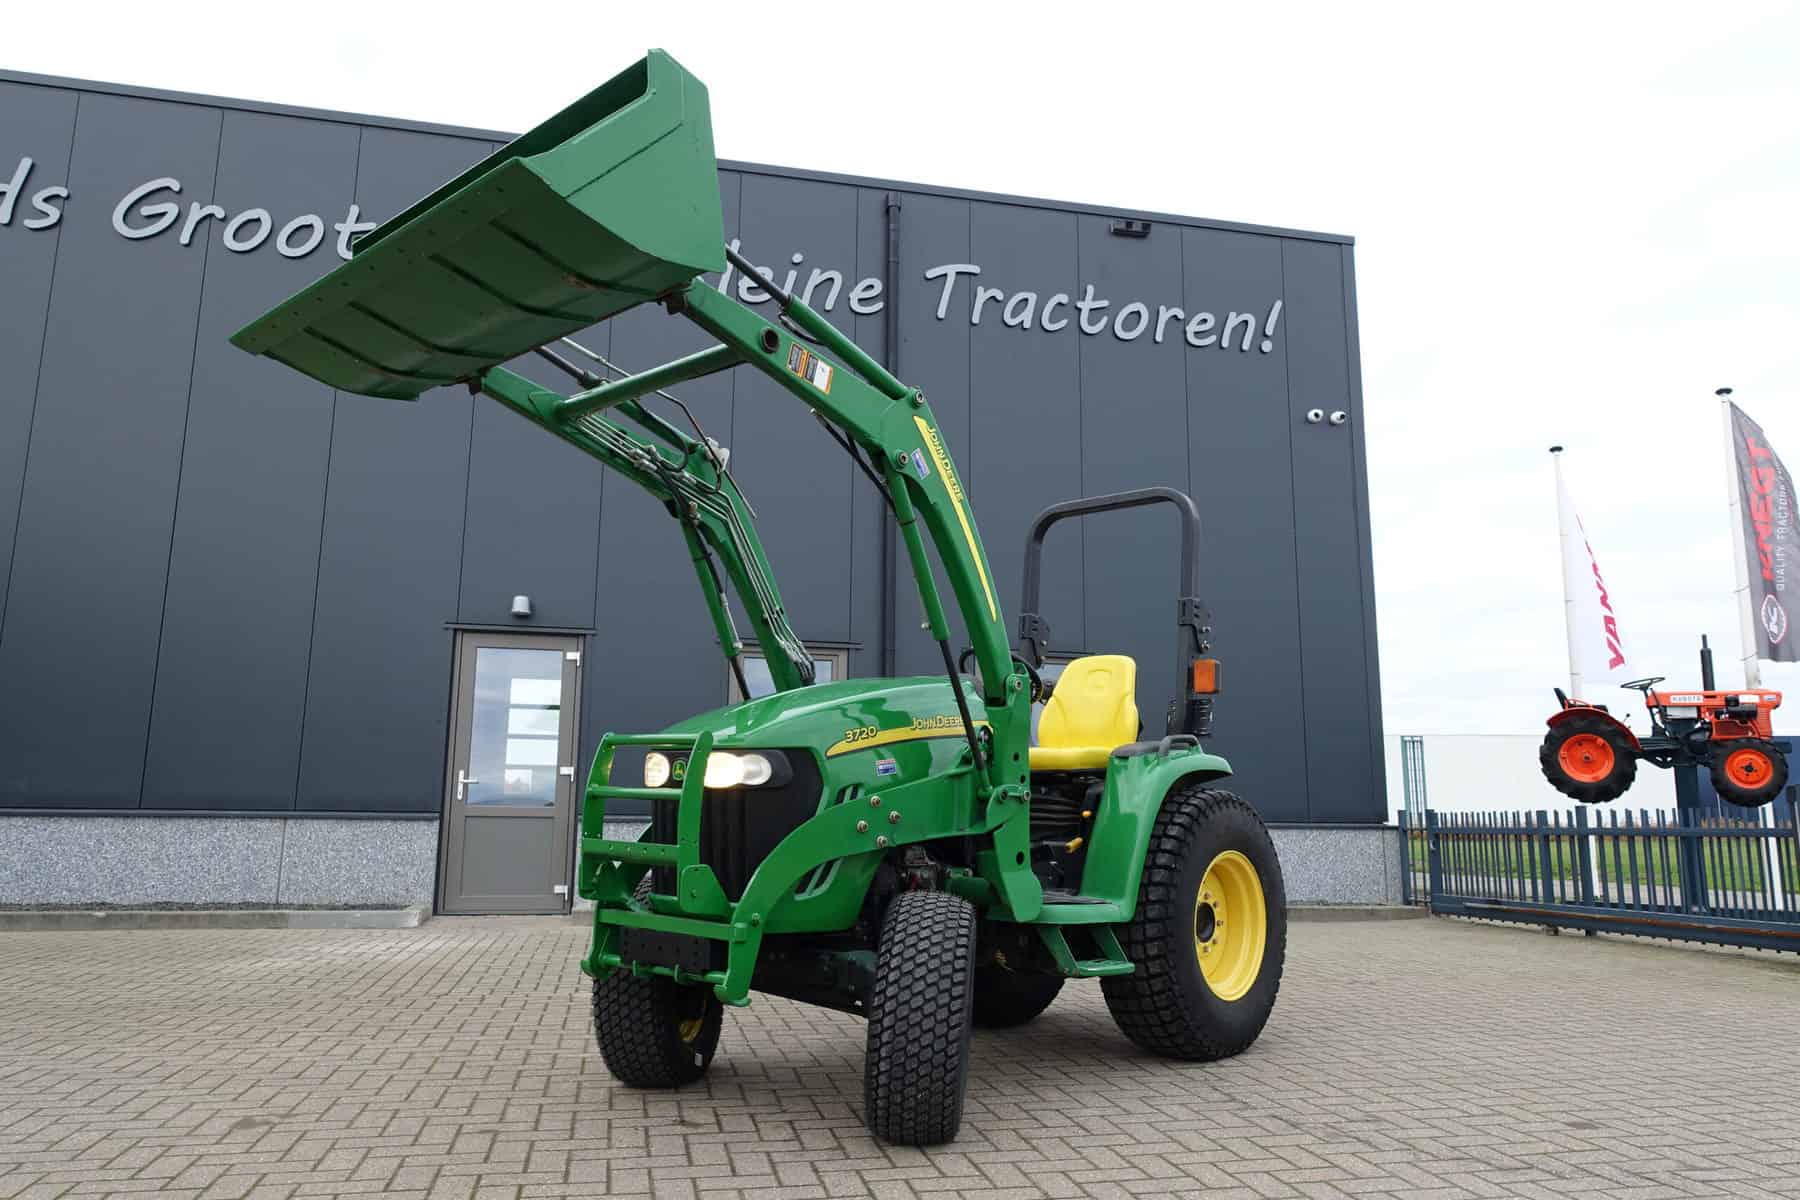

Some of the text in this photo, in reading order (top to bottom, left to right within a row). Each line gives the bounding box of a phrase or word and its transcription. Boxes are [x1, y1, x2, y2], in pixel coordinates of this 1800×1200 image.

[717, 238, 884, 314] leine
[924, 263, 1282, 353] Tractoren!
[927, 427, 946, 460] JOHN
[1747, 436, 1777, 581] KNEGT
[845, 726, 878, 742] 3720
[911, 714, 964, 730] JOHN DEER
